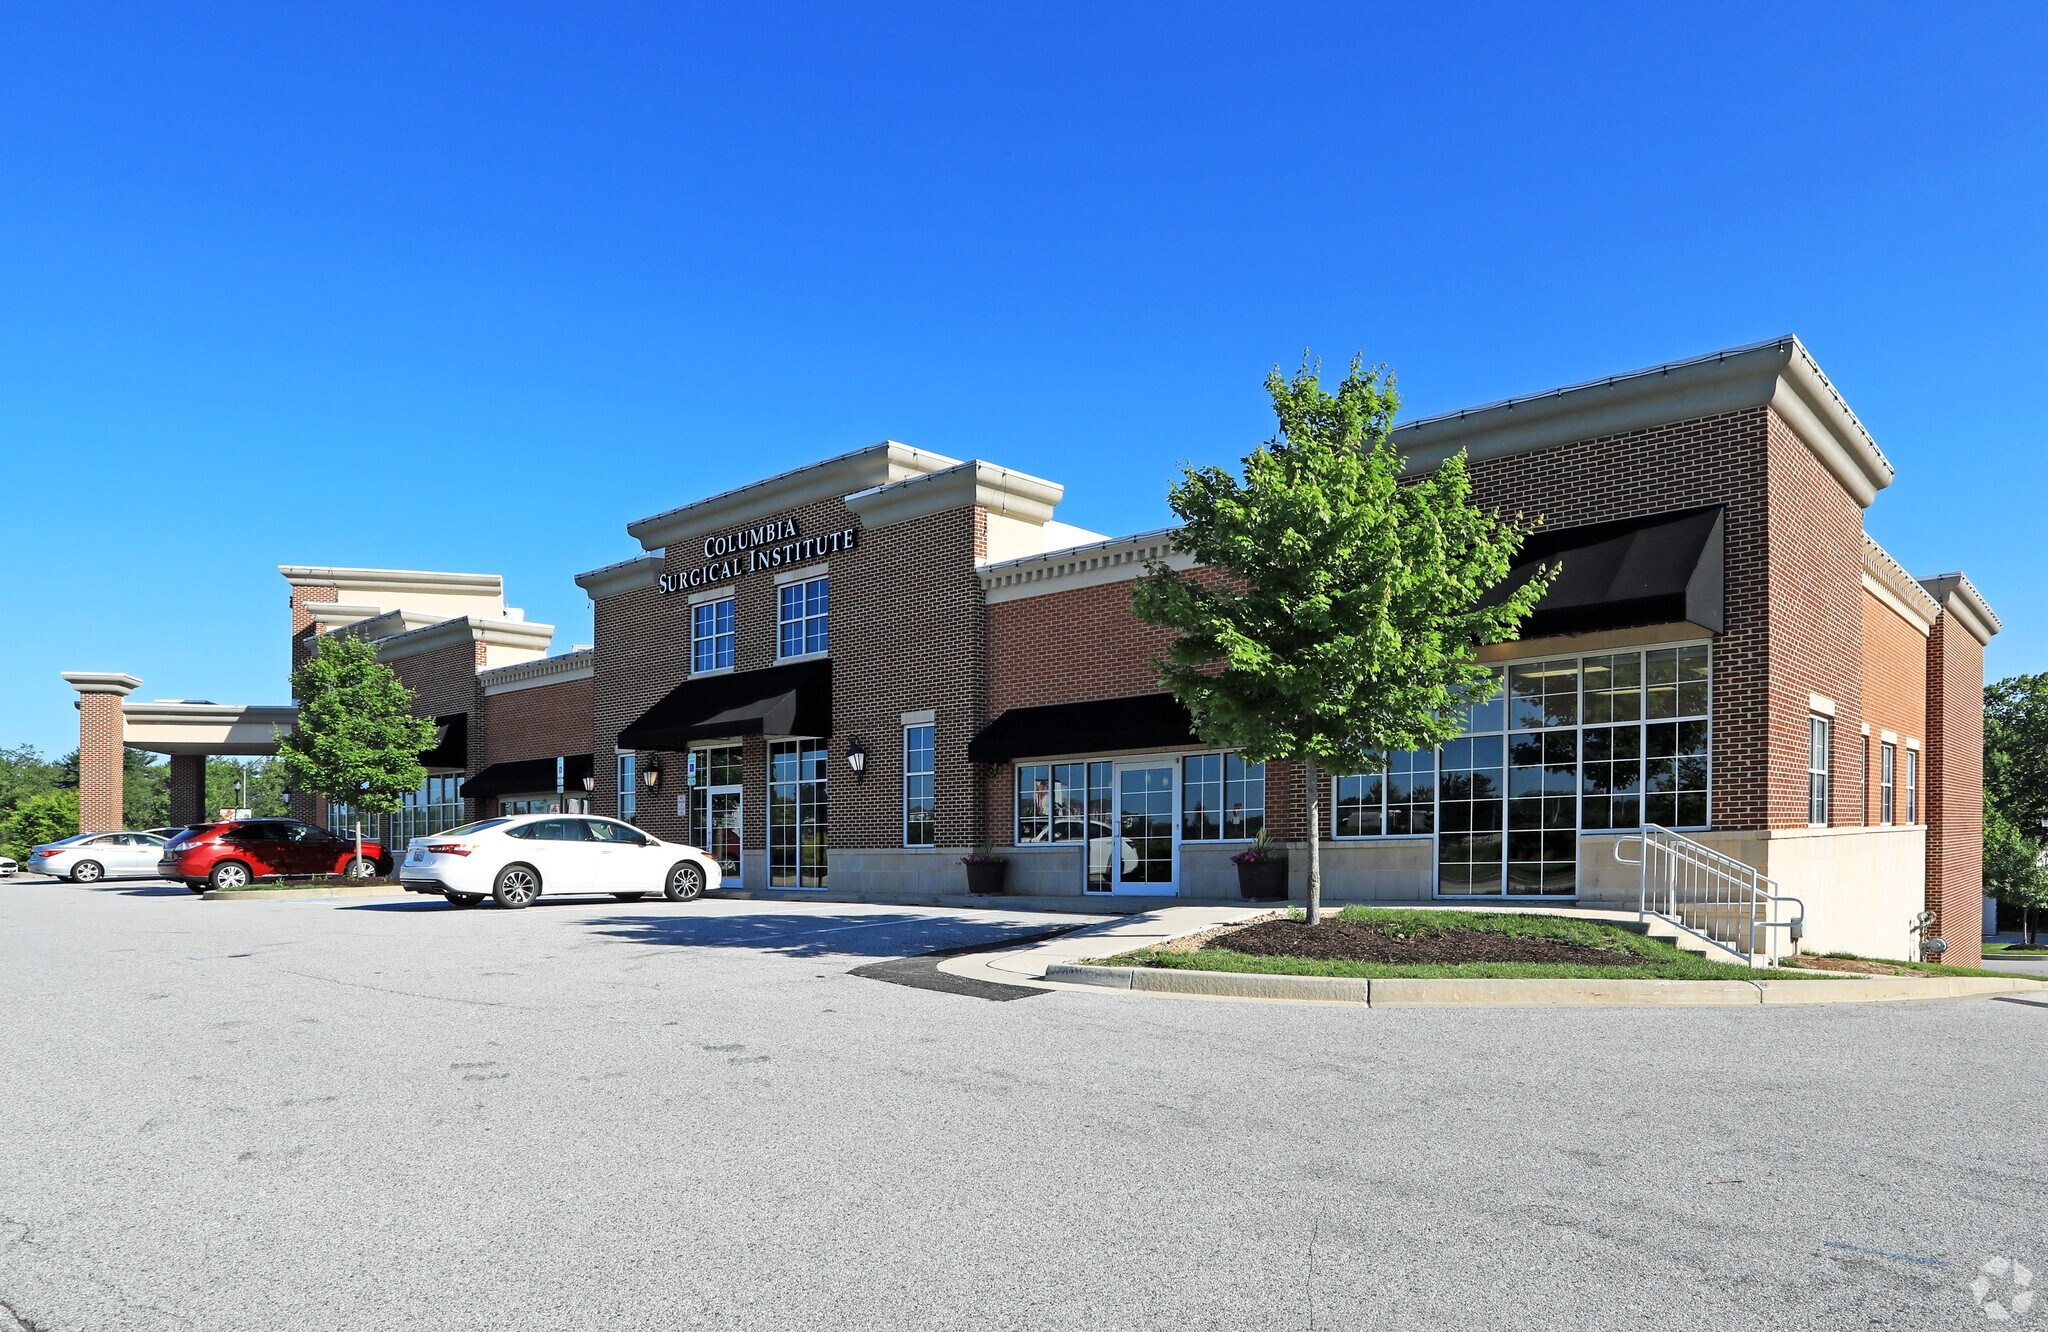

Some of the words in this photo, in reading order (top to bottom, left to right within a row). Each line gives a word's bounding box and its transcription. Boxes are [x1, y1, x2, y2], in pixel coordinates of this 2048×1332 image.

[659, 558, 742, 594] SURGICAL
[749, 528, 853, 572] INSTITUTE
[704, 518, 796, 558] COLUMBIA
